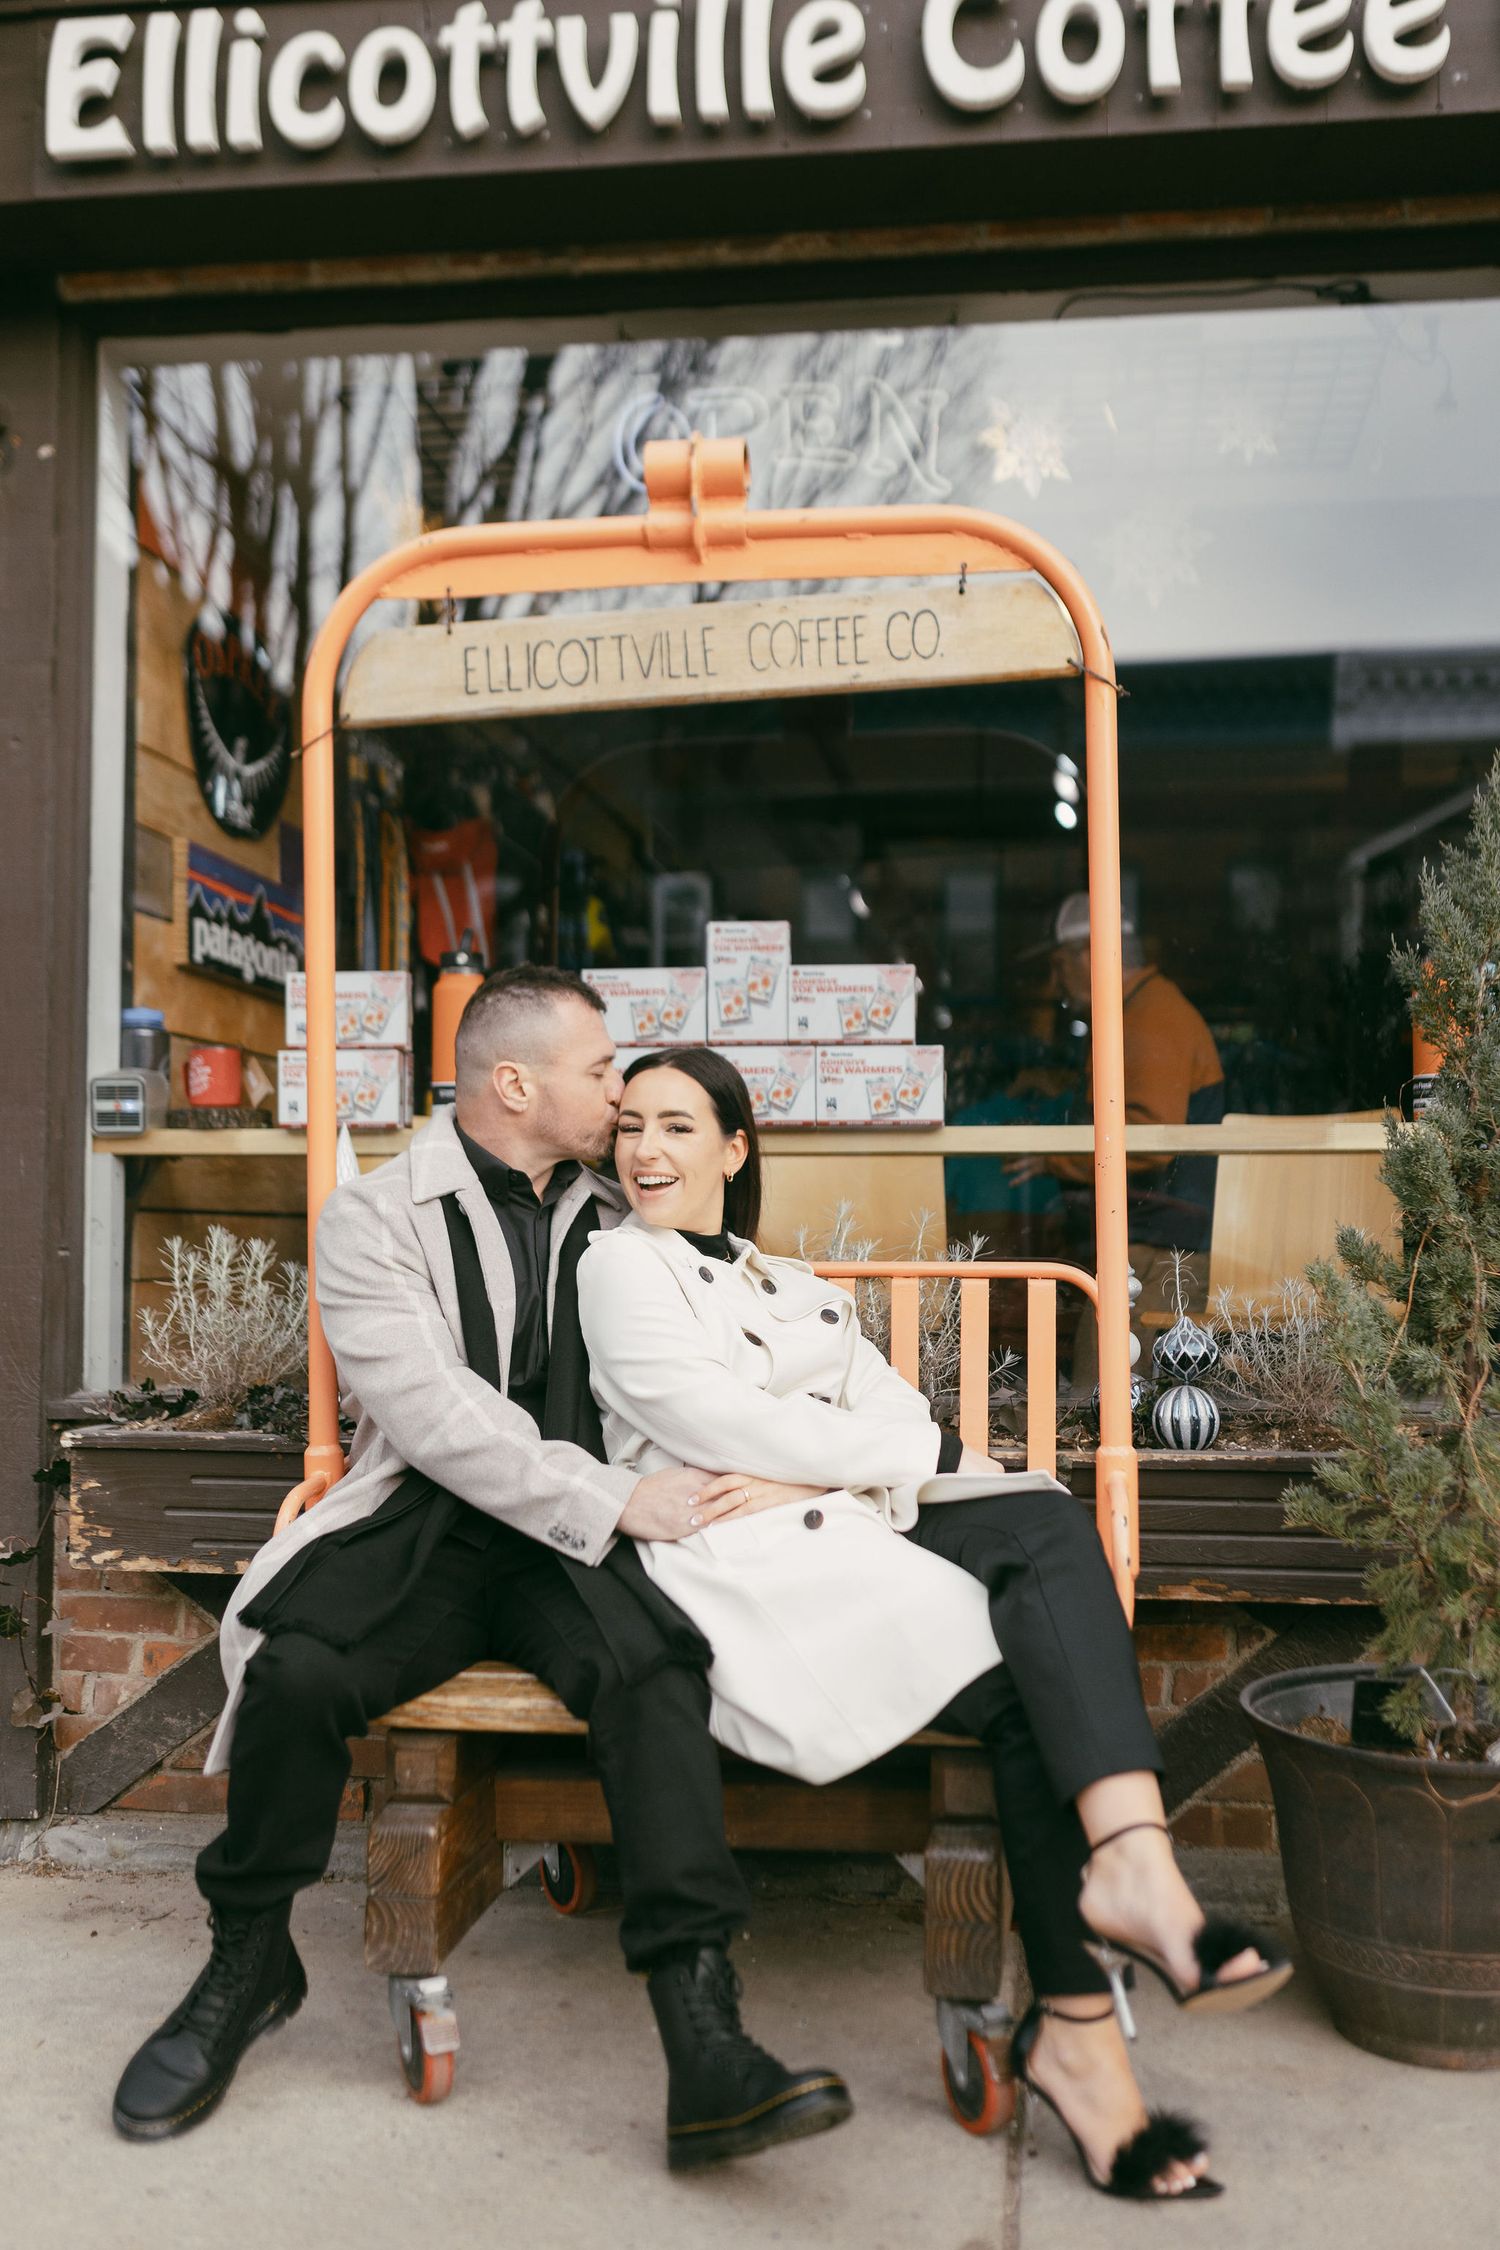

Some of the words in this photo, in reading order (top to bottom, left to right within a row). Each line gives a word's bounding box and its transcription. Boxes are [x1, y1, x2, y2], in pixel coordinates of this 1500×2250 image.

[44, 0, 868, 163] Ellicottville
[463, 626, 716, 696] ELLICOTTVILLE
[748, 614, 870, 672] COFFEE
[886, 608, 945, 662] CO.
[844, 1065, 903, 1074] WARMERS
